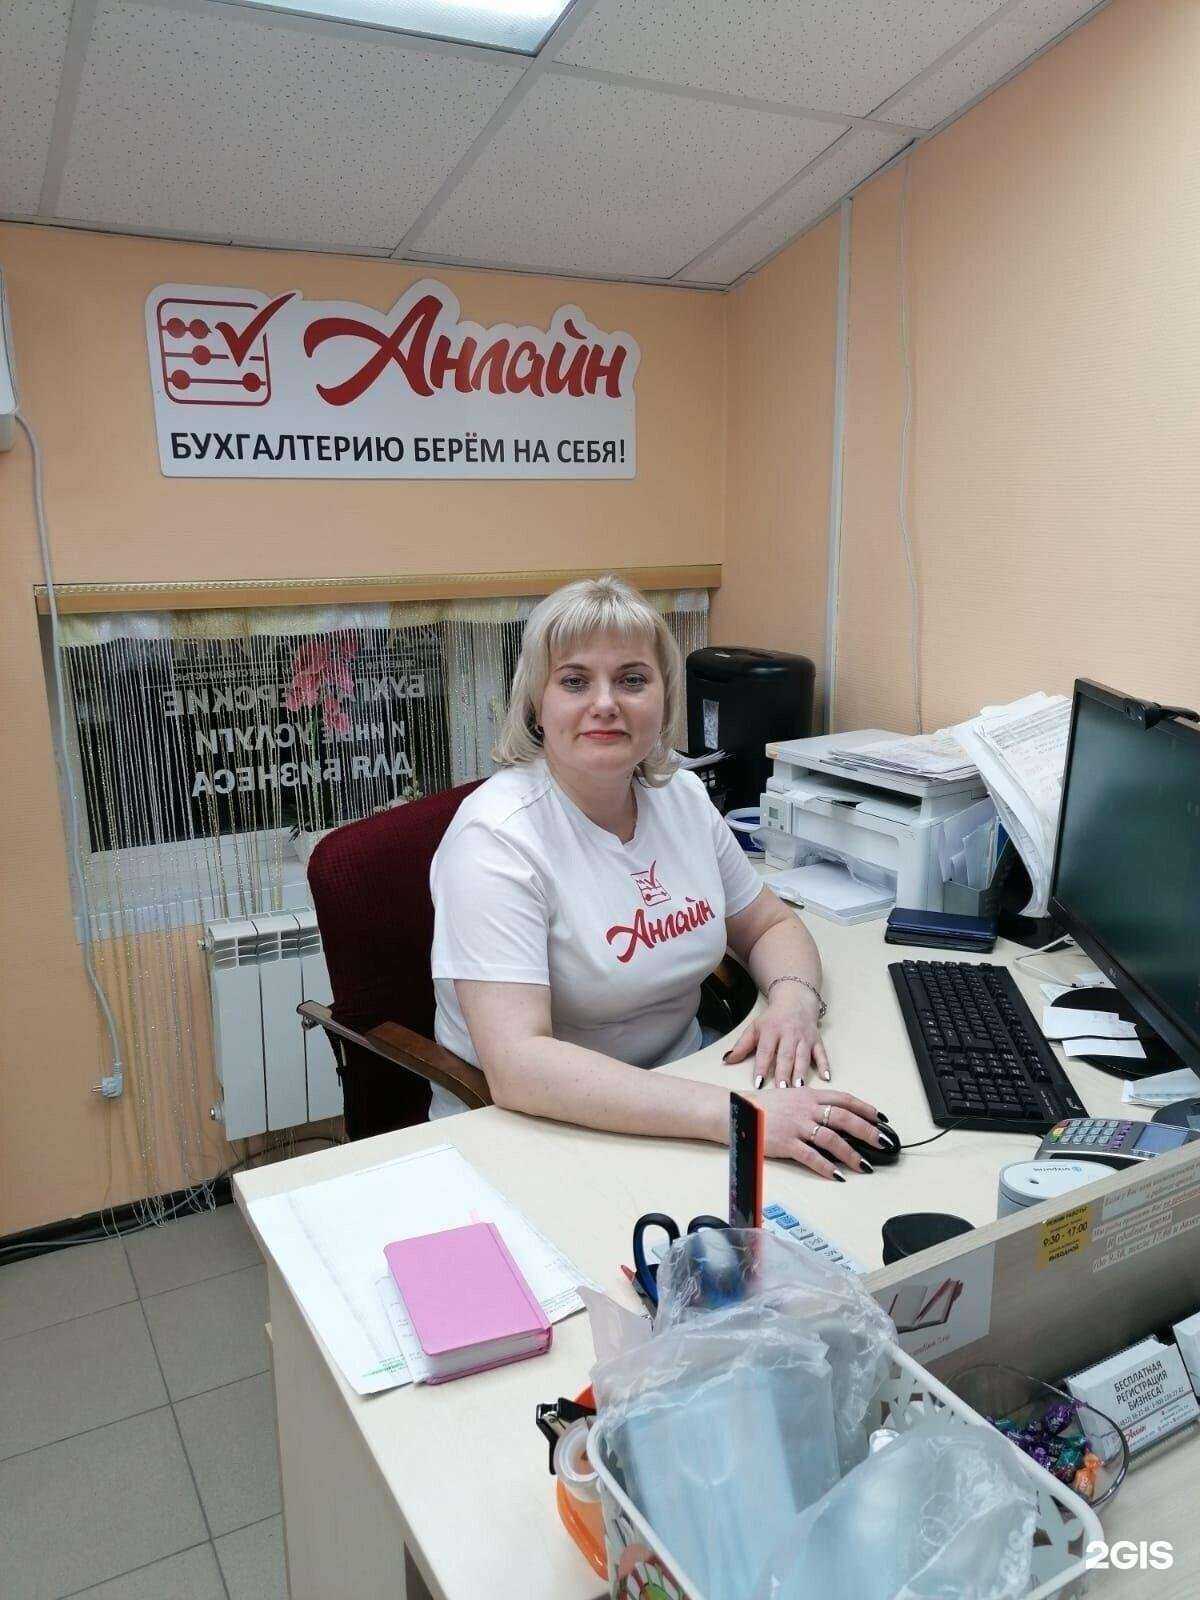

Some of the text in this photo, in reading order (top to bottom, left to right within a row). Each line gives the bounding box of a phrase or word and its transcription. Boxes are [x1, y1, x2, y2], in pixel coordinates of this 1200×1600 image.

[303, 295, 627, 407] Анлайн
[171, 431, 626, 465] БУХГАЛТЕРИЮ БЕРЁМ НА СЕБЯ!
[606, 896, 715, 963] Анлайн
[1114, 1360, 1163, 1393] БЕСПЛАТНАЯ
[1116, 1370, 1168, 1405] РЕГИСТРАЦИЯ
[1127, 1384, 1165, 1411] БИЗНЕСА!
